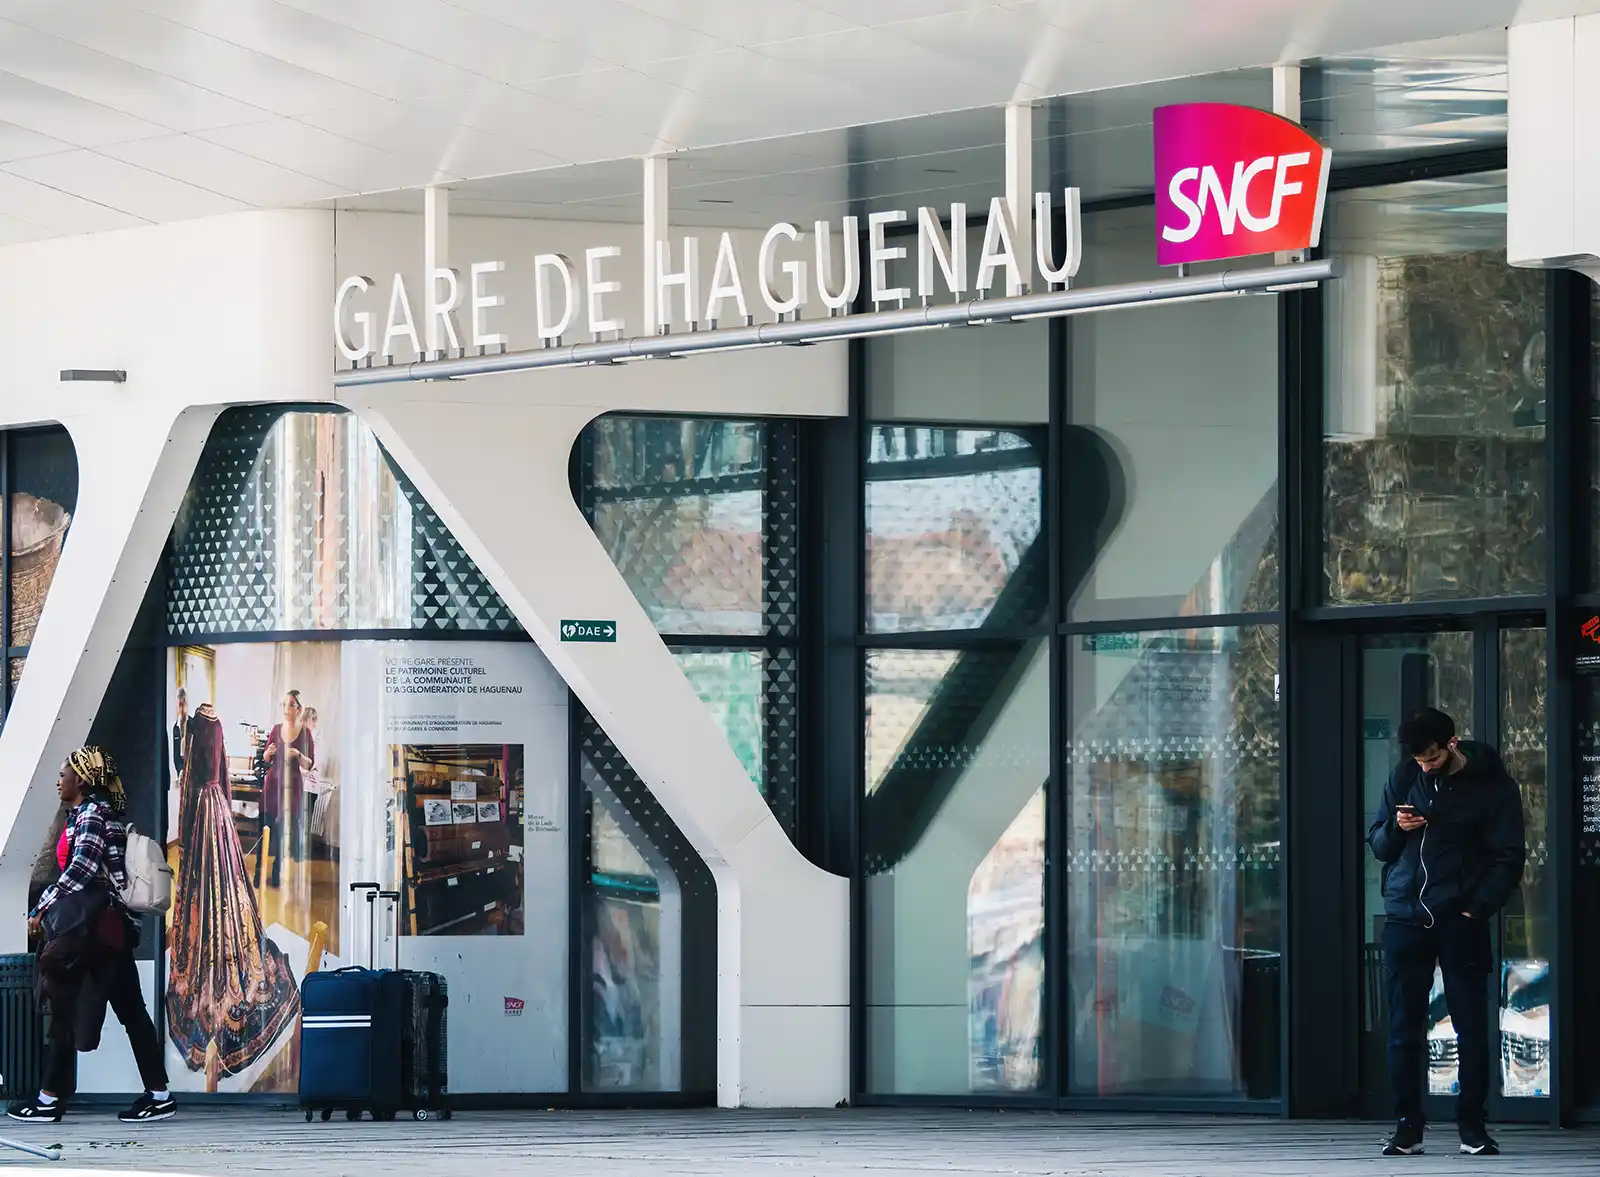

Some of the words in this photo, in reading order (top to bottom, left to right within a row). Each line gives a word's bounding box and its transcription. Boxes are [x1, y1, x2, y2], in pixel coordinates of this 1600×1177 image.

[1161, 151, 1310, 243] SNCF
[334, 261, 507, 361] GARE
[535, 246, 625, 339] DE
[656, 187, 1082, 325] HAGUENAU
[578, 626, 601, 636] DAE
[414, 658, 436, 666] GARE
[437, 657, 475, 666] PRÉSENTE
[385, 667, 396, 675] LE
[398, 667, 448, 675] PATRIMOINE
[449, 667, 487, 675] CULTUREL
[385, 676, 397, 684] DE
[400, 676, 411, 684] LA
[413, 676, 472, 684] COMMUNAUTÉ
[385, 685, 465, 694] D'AGGLOMÉRATION
[467, 685, 478, 693] DE
[480, 685, 523, 693] HAGUENAU
[506, 1001, 523, 1009] SNCF
